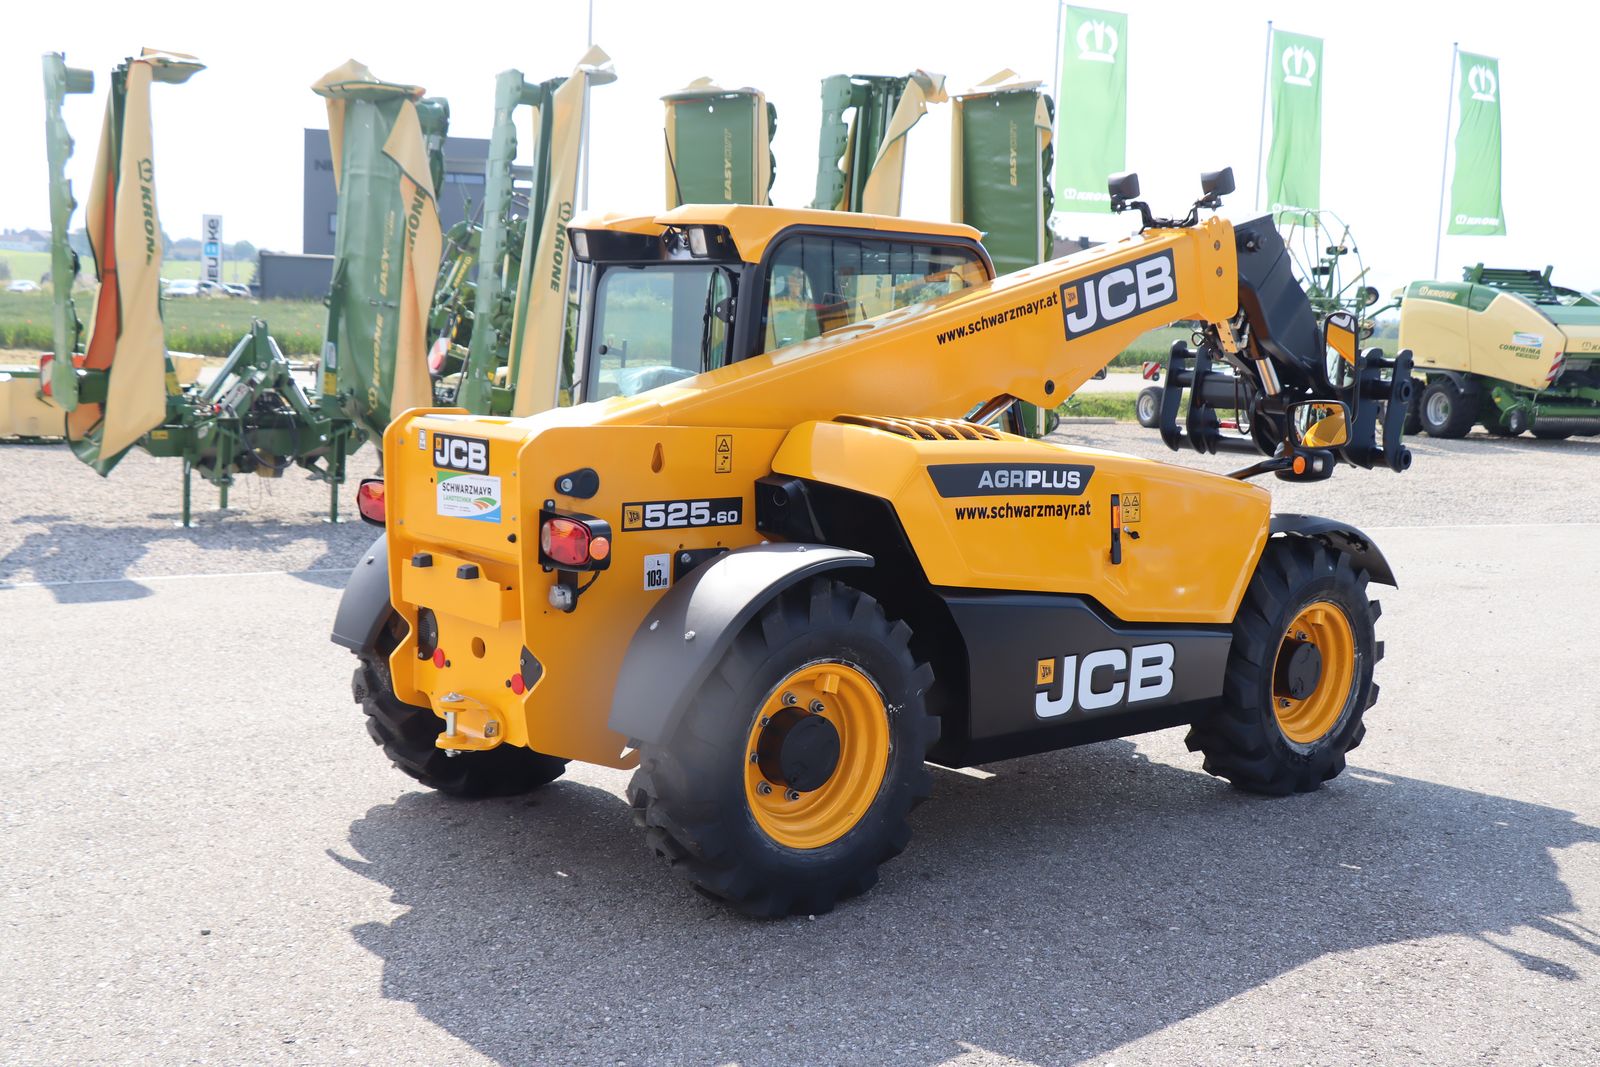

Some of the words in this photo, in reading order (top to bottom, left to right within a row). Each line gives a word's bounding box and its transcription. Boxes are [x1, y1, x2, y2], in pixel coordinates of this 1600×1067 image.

[1077, 191, 1112, 201] KRON
[550, 222, 568, 293] KRONE
[1066, 255, 1175, 334] JCB
[936, 290, 1058, 346] www.schwarzmayr.at
[372, 313, 385, 388] KRONE
[1498, 343, 1541, 355] COMPRIMA
[435, 438, 487, 472] JCB
[442, 482, 492, 497] SCHWARZMAYR
[977, 469, 1082, 489] AGRIPLUS
[955, 500, 1092, 520] www.schwarzmayr.at
[646, 569, 662, 587] 103
[1035, 642, 1175, 718] JCB
